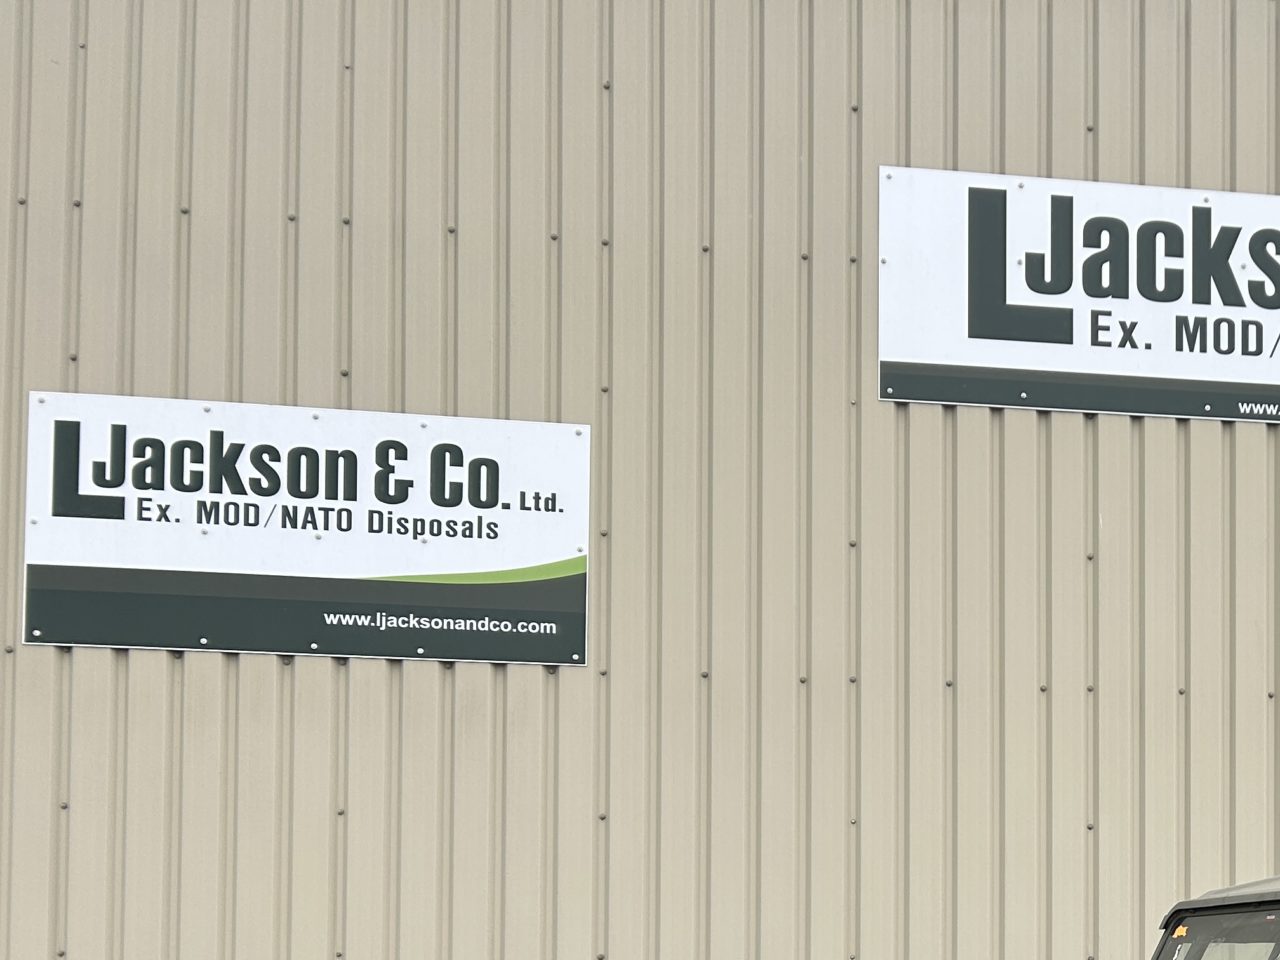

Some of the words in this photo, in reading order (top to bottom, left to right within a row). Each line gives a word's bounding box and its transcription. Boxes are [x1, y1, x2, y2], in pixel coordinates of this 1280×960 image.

[1090, 309, 1153, 351] Ex.
[374, 439, 414, 505] &
[429, 443, 511, 510] Co.
[519, 490, 565, 513] Ltd.
[136, 497, 180, 524] Ex.
[196, 500, 353, 533] MOD/NATO
[367, 509, 499, 541] Disposals
[323, 611, 557, 634] www.ljacksonandco.com
